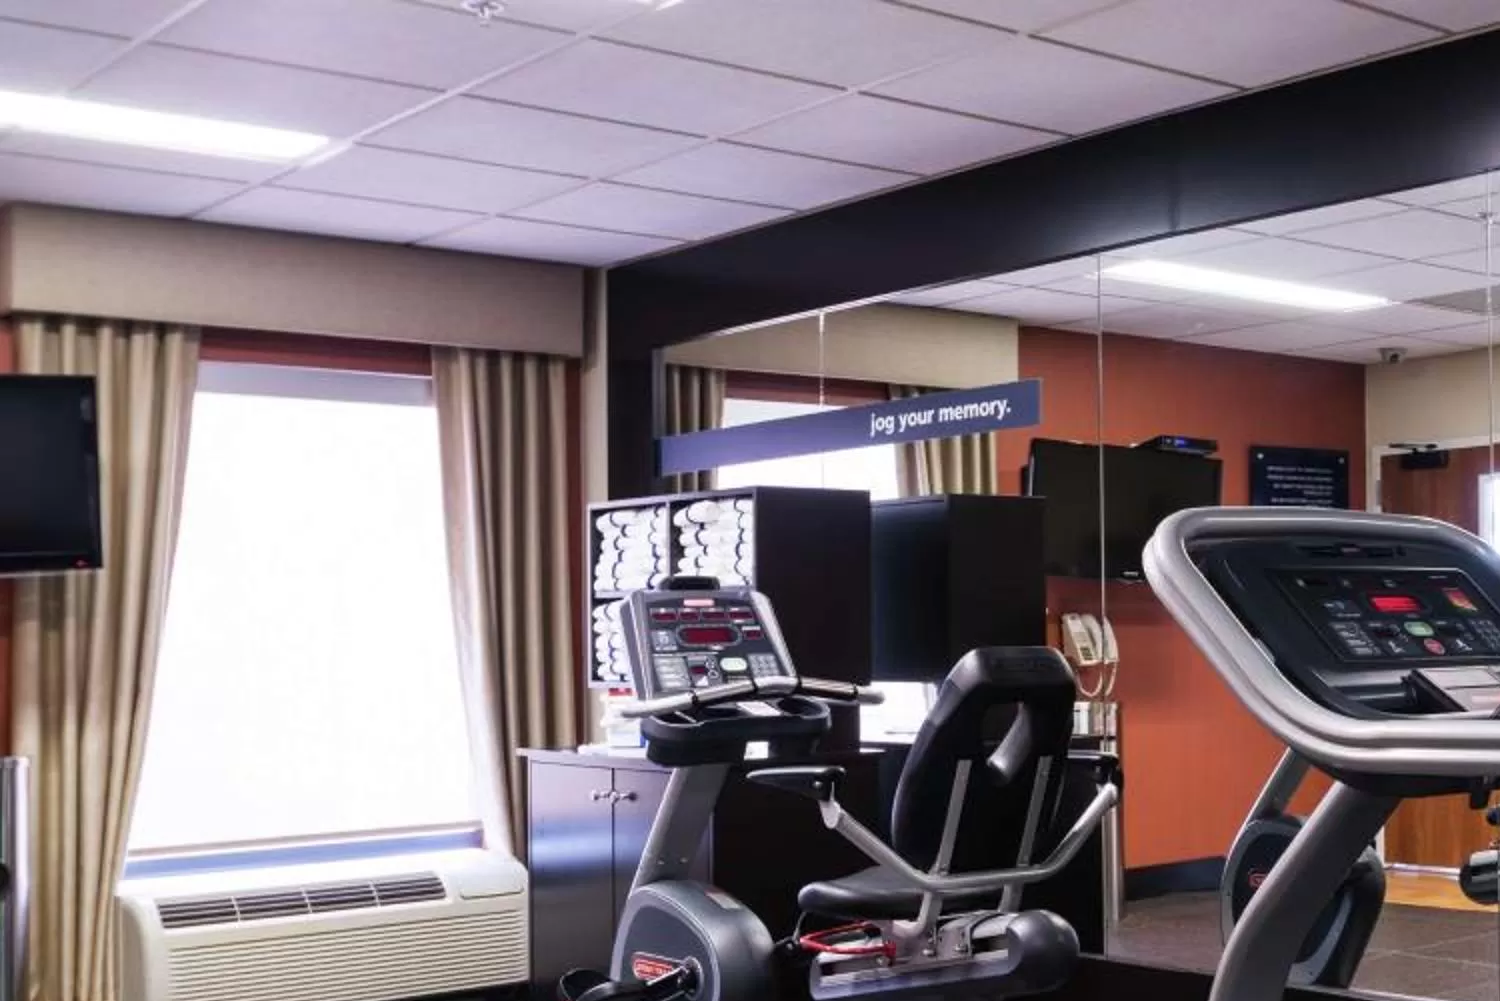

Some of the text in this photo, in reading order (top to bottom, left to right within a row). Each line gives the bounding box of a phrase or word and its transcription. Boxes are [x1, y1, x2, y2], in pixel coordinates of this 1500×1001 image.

[869, 398, 1011, 437] jog your memory.
